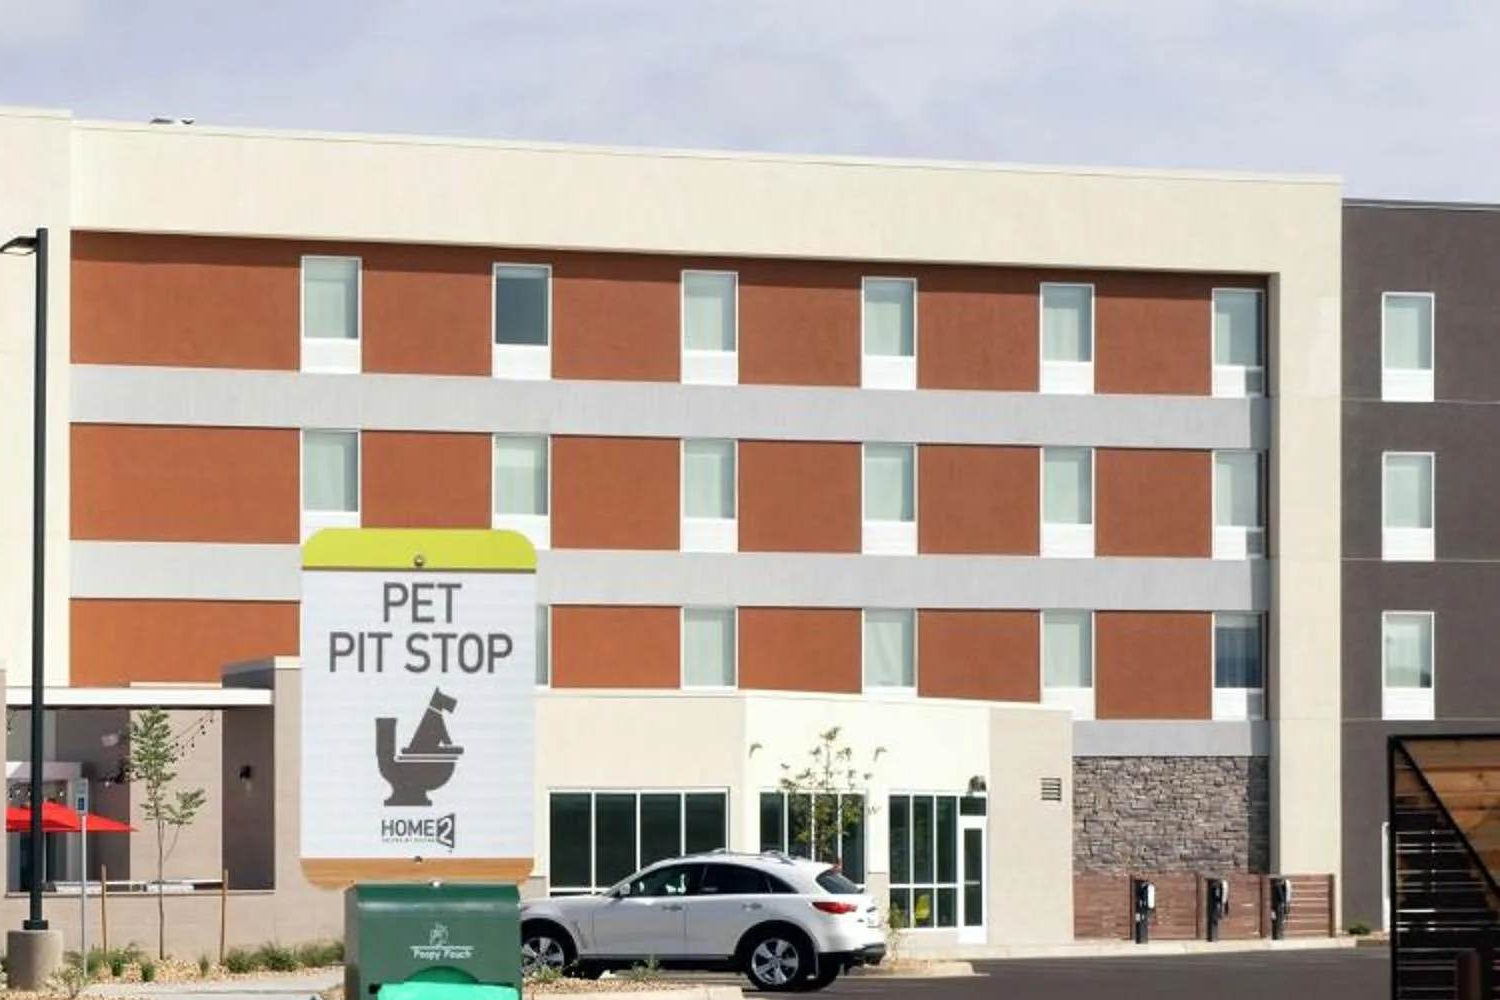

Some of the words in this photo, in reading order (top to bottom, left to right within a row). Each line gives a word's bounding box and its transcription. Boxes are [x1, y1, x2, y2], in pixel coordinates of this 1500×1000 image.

[383, 582, 462, 623] PET
[329, 632, 393, 673] PIT
[404, 632, 513, 674] STOP
